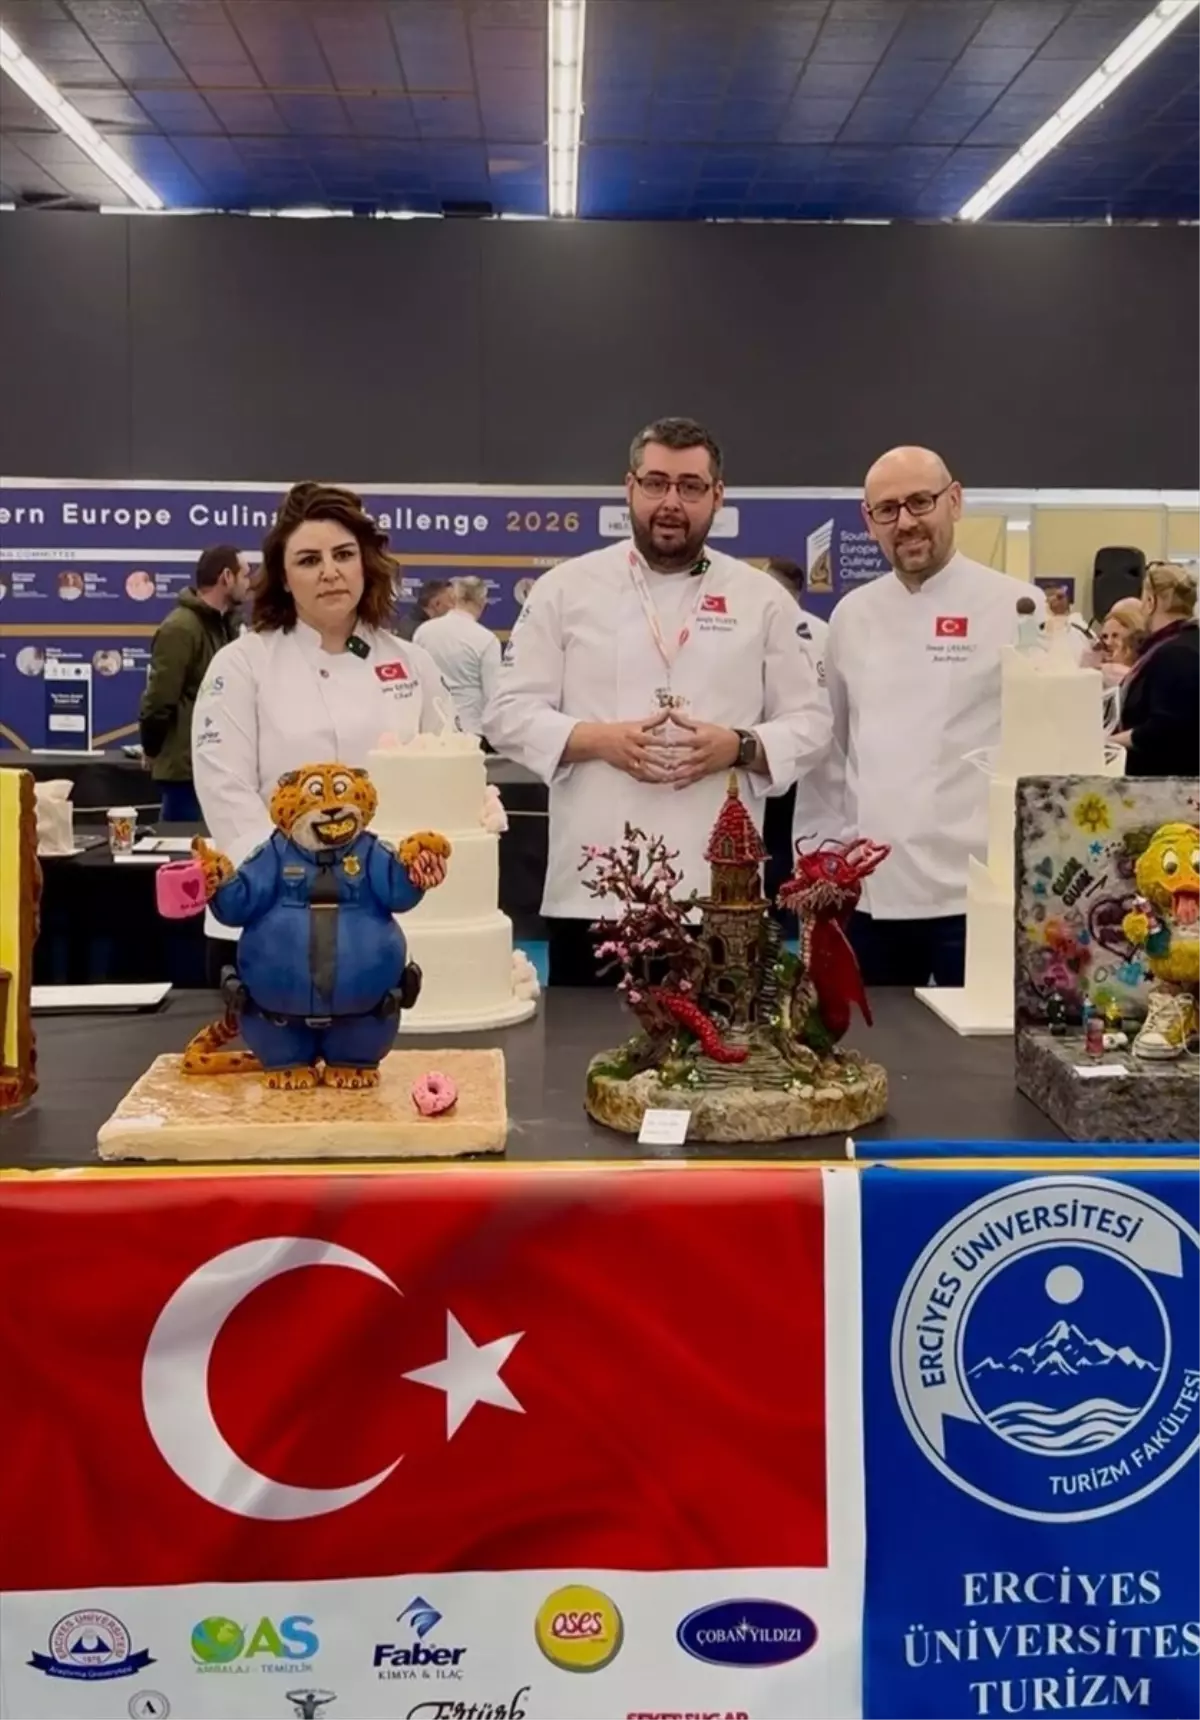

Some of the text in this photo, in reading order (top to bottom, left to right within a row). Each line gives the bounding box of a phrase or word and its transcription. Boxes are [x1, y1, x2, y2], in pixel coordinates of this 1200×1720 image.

[62, 502, 172, 530] Europe
[505, 511, 580, 532] 2026
[840, 542, 879, 556] Europe
[916, 1198, 1144, 1389] ERCİYES ÜNİVERSİTESİ
[1049, 1458, 1132, 1496] TURİZM
[962, 1565, 1162, 1607] ERCİYES
[696, 1628, 802, 1646] ÇOBAN YILDIZI
[903, 1619, 1200, 1668] ÜNİVERSİTES
[261, 1663, 313, 1674] TEMİZLİK
[372, 1642, 467, 1667] Faber
[378, 1669, 417, 1681] KİMYA
[422, 1669, 430, 1679] &
[968, 1667, 1152, 1715] TURİZM
